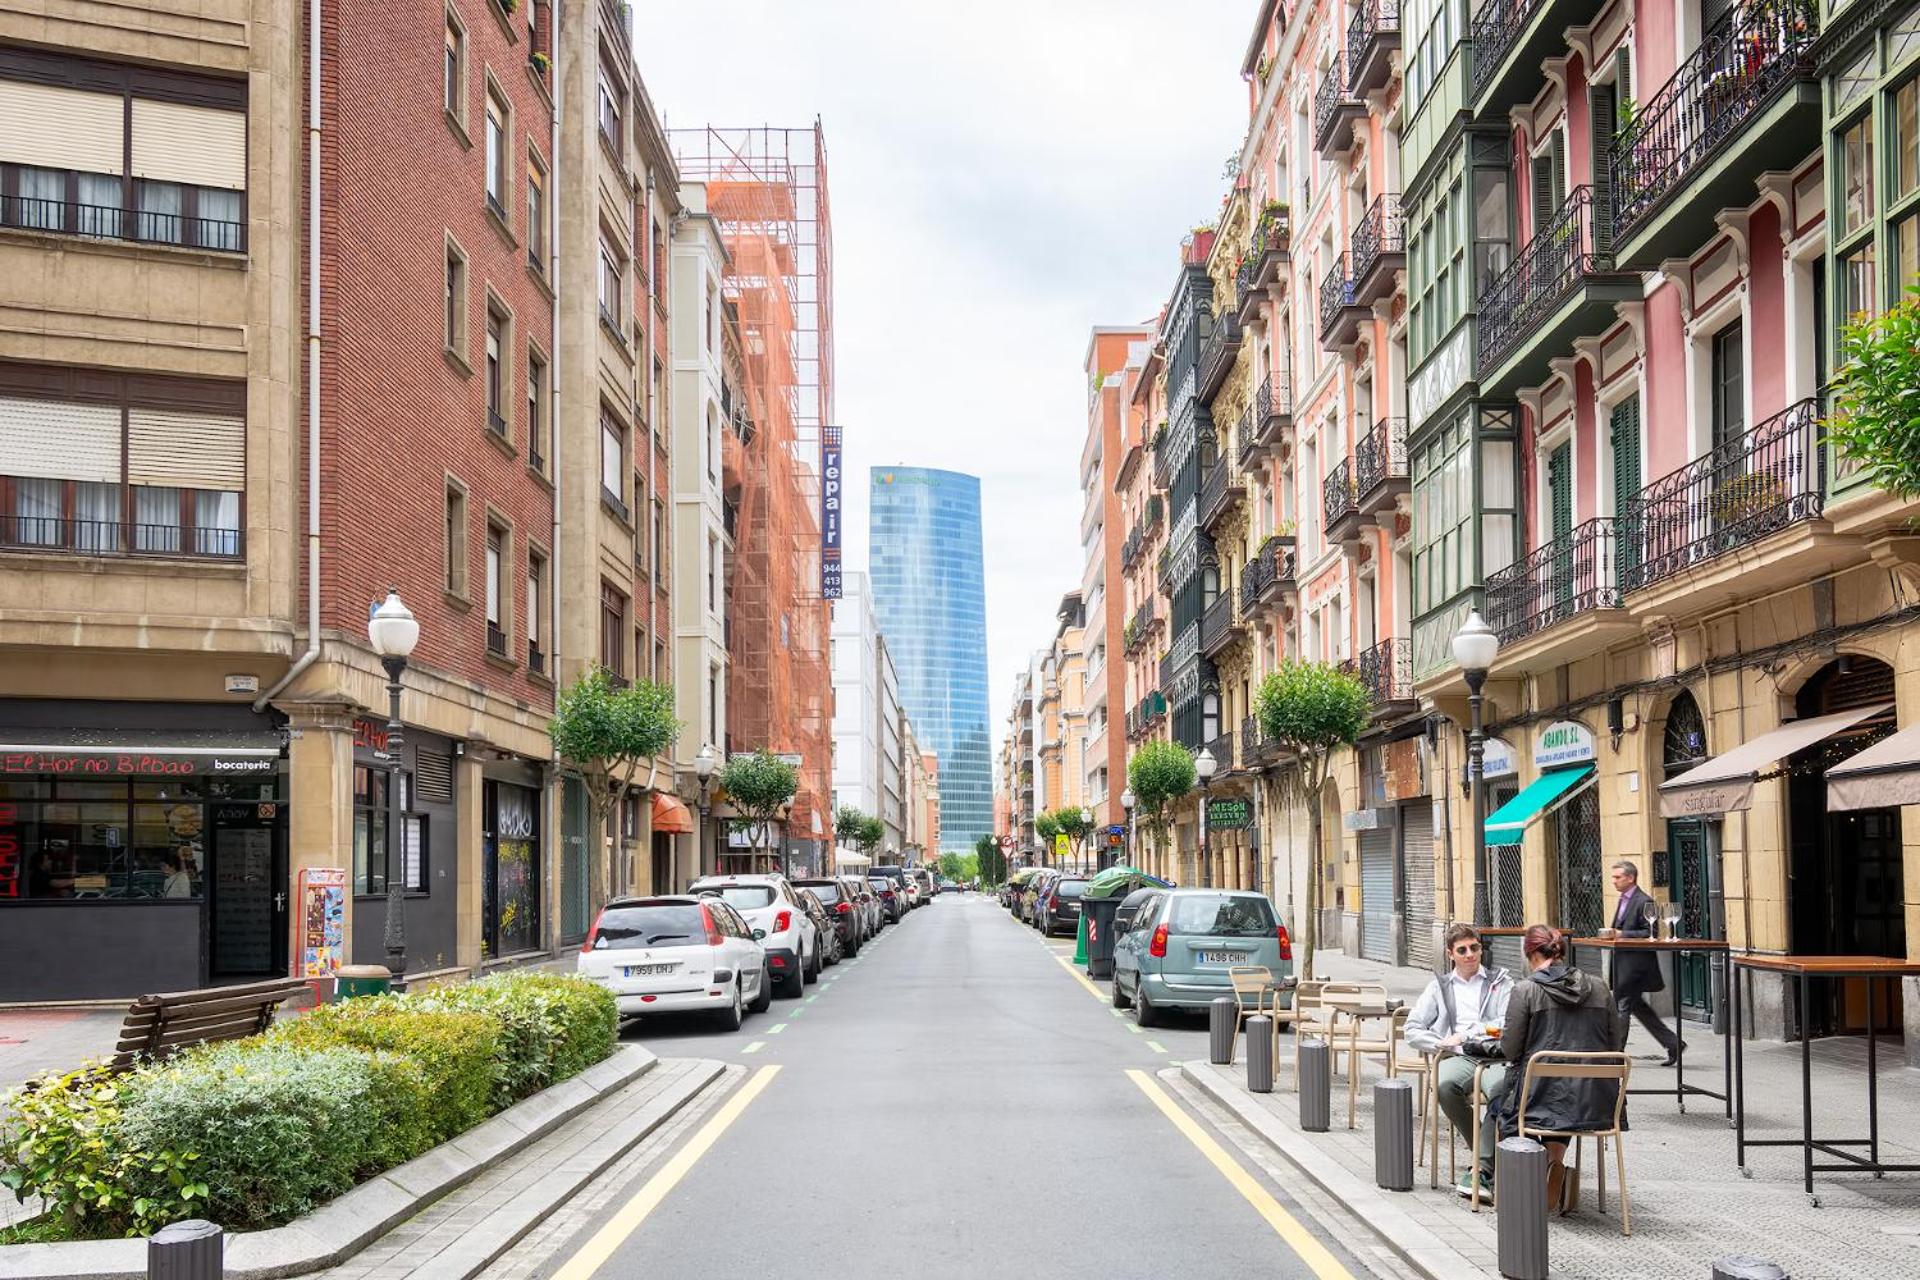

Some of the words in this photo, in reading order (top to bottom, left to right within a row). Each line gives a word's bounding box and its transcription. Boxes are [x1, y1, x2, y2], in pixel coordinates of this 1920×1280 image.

[826, 453, 839, 544] repair
[823, 564, 841, 573] 944
[824, 576, 841, 585] 413
[824, 588, 841, 597] 962
[5, 754, 33, 773] El
[116, 754, 195, 774] Bilbao
